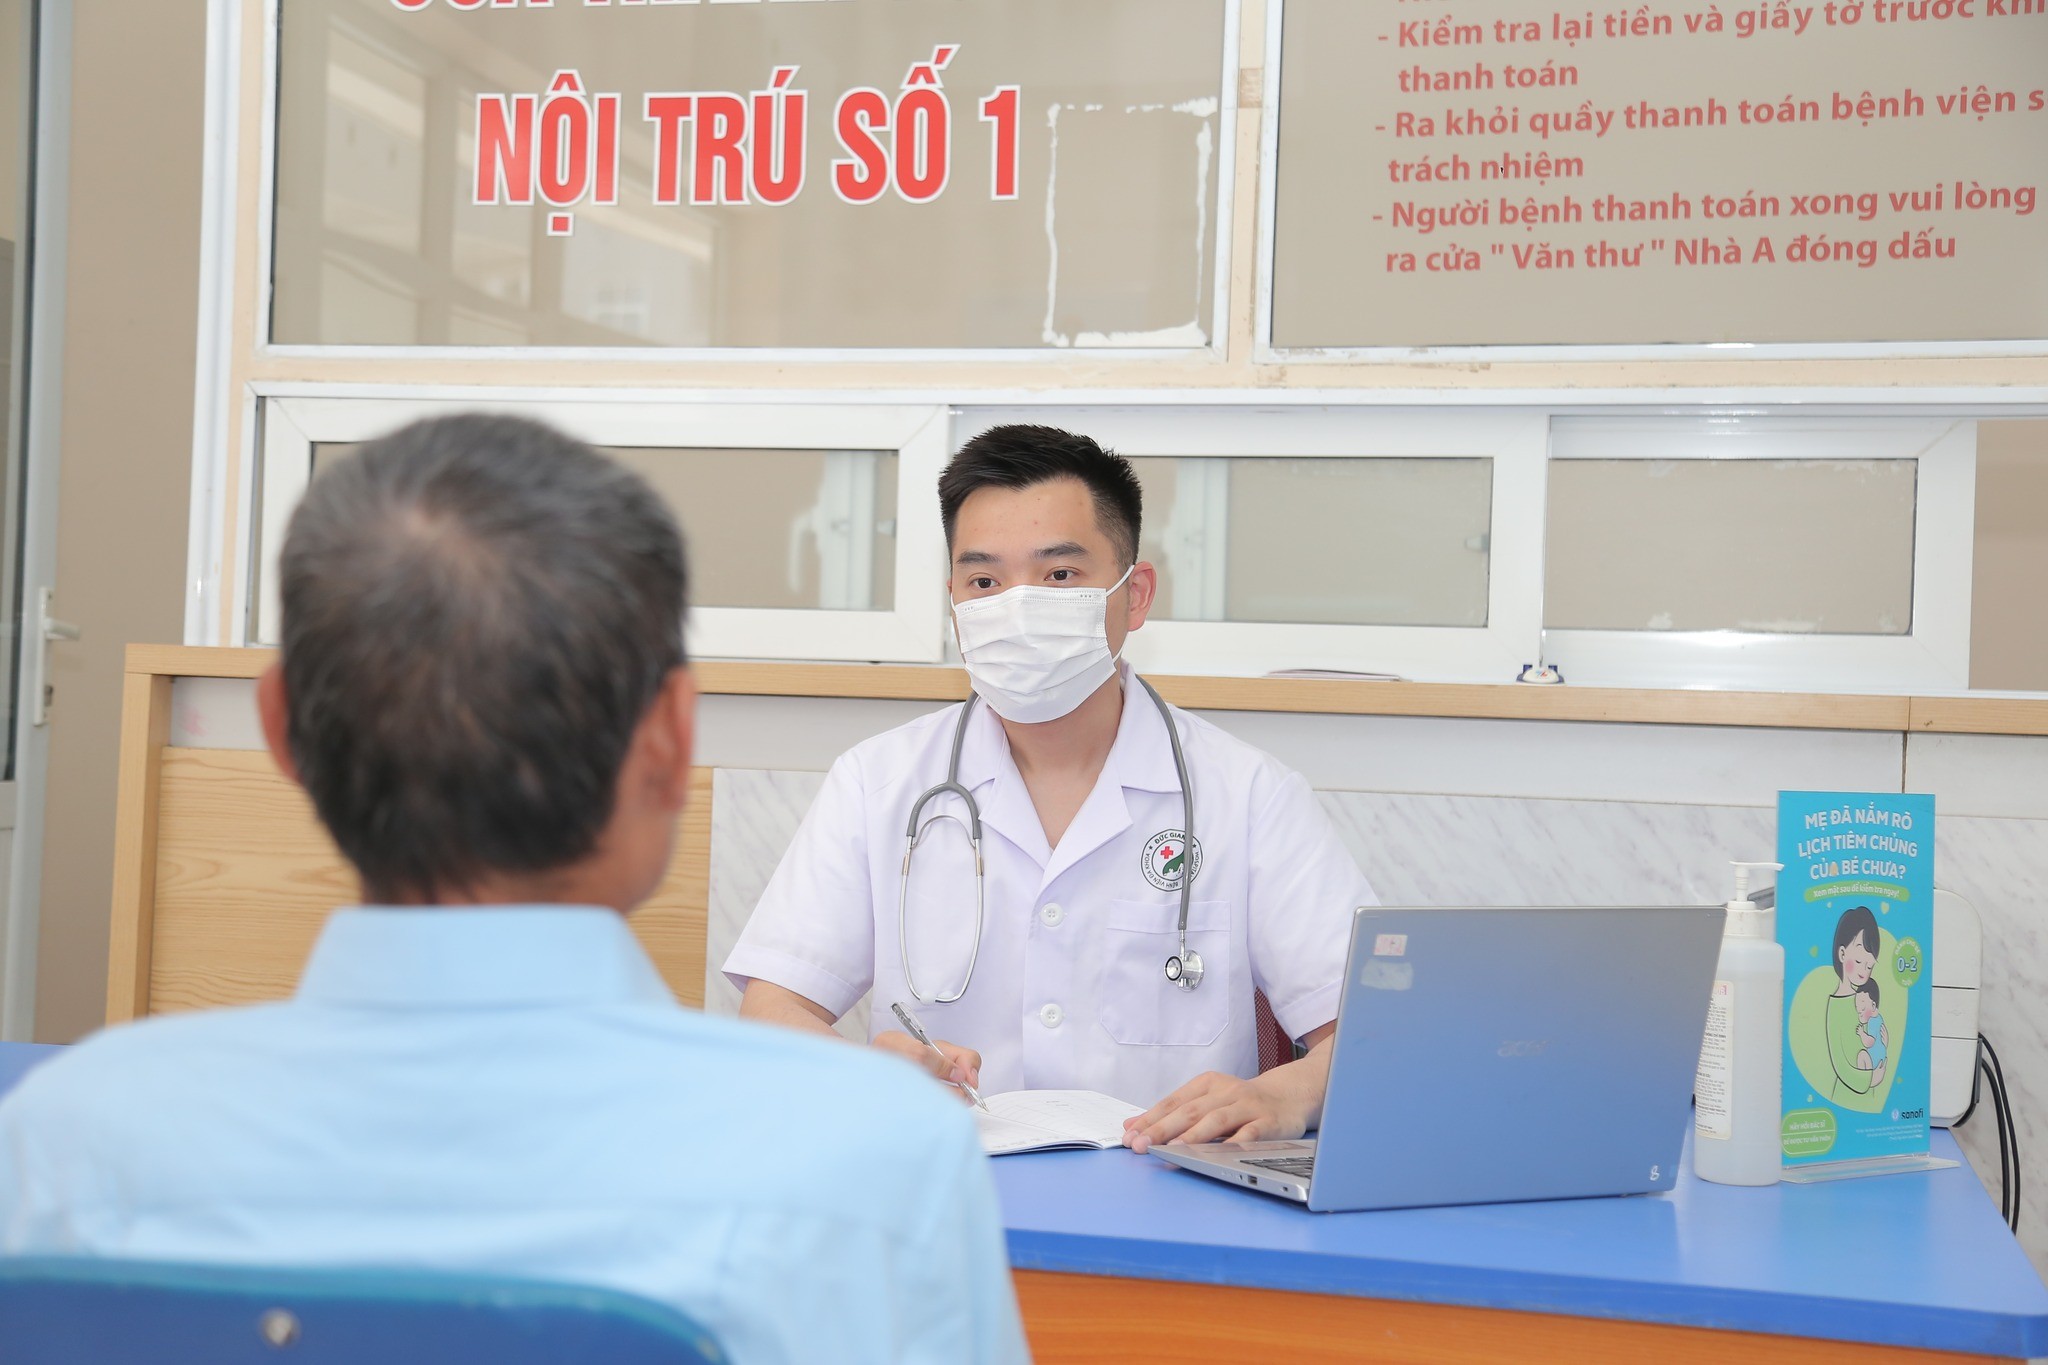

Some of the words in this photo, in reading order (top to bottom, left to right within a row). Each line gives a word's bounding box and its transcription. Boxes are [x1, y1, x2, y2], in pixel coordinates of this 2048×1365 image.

[1398, 14, 1484, 48] Kiểm
[1493, 18, 1542, 44] tra
[1552, 11, 1594, 48] lại
[1603, 4, 1674, 38] tiền
[1683, 3, 1725, 34] và
[1734, 0, 1814, 39] giấy
[1398, 62, 1494, 94] thanh
[1503, 59, 1579, 90] toán
[1394, 111, 1436, 138] Ra
[1445, 104, 1520, 137] khỏi
[1528, 99, 1616, 140] quầy
[1623, 97, 1728, 131] thanh
[1738, 93, 1821, 125] toán
[1831, 87, 1926, 128] bệnh
[1936, 84, 2017, 122] viện
[2027, 89, 2048, 112] s
[474, 69, 621, 236] NỘI
[644, 66, 808, 206] TRÚ
[831, 44, 961, 206] SỐ
[978, 85, 1021, 201] 1
[1387, 152, 1472, 184] trách
[1480, 150, 1585, 187] nhiệm
[1391, 198, 1490, 235] Người
[1498, 195, 1584, 232] bệnh
[1591, 191, 1694, 224] thanh
[1701, 189, 1781, 219] toán
[1789, 191, 1879, 222] xong
[1888, 182, 1944, 213] vui
[1953, 180, 2037, 216] lòng
[1385, 250, 1418, 273] ra
[1424, 242, 1482, 273] cửa
[1510, 240, 1576, 271] Văn
[1583, 239, 1646, 269] thư
[1674, 235, 1743, 266] Nhà
[1751, 235, 1777, 265] A
[1785, 233, 1879, 270] đóng
[1887, 226, 1957, 261] dấu
[1804, 811, 1829, 832] MẸ
[1829, 804, 1853, 826] ĐÃ
[1855, 801, 1889, 826] NẮM
[1891, 811, 1913, 831] RÕ
[1154, 832, 1169, 845] ĐỨC
[1169, 832, 1186, 840] GIAN
[1798, 836, 1832, 860] LỊCH
[1833, 830, 1868, 851] TIÊM
[1869, 832, 1919, 858] CHỦNG
[1147, 870, 1155, 879] ĐA
[1191, 851, 1199, 877] HOSPITA
[1810, 857, 1840, 880] CỦA
[1841, 855, 1860, 875] BÉ
[1861, 860, 1907, 880] CHƯA?
[1153, 877, 1166, 888] VIỆN
[1165, 881, 1179, 889] BỆNH
[1897, 955, 1918, 973] 0-2
[1901, 1107, 1924, 1120] sanofi
